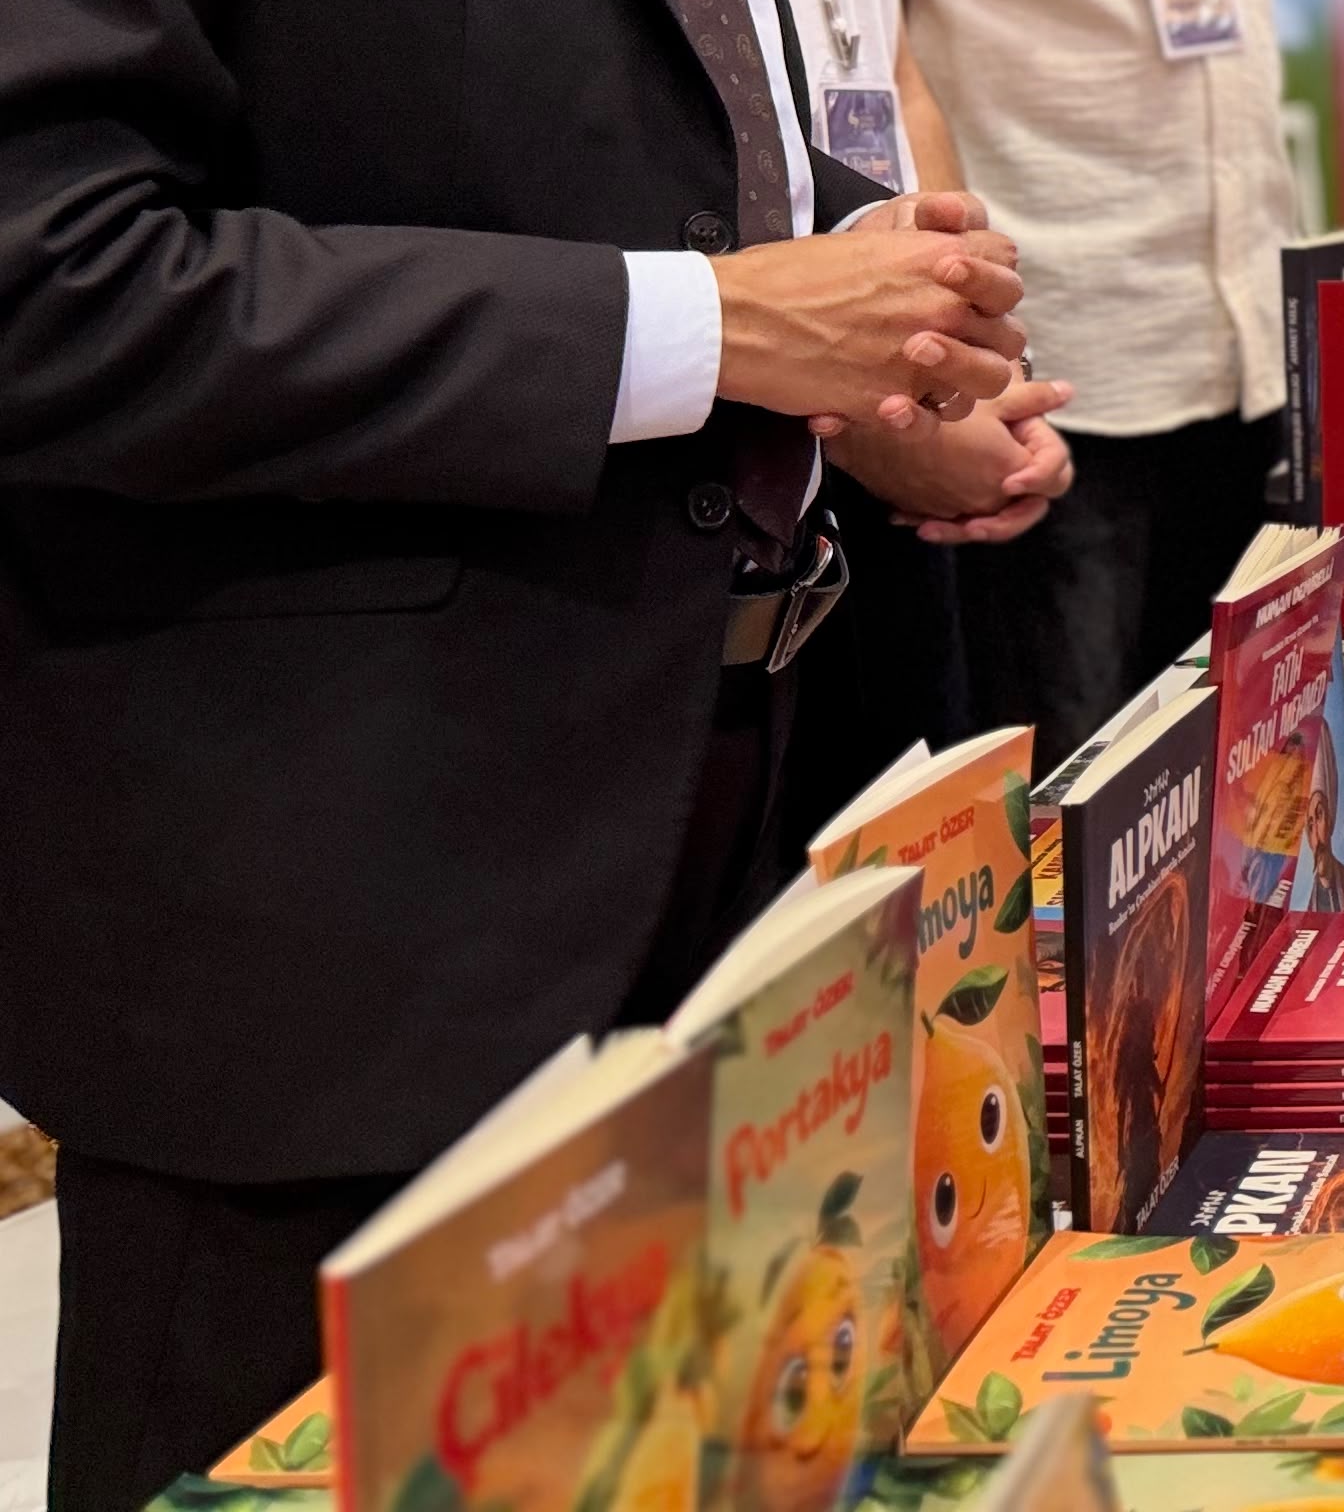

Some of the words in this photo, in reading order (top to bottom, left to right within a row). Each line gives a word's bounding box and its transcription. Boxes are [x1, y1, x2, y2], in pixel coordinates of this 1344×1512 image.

[1255, 590, 1291, 628] NUMAN
[1291, 556, 1335, 607] DEMİRELLİ
[1270, 644, 1304, 706] FATİH
[1226, 709, 1278, 784] SULTAN
[1278, 670, 1328, 740] MEHMED
[898, 833, 936, 866] TALAT
[939, 806, 975, 846] ÖZER
[1108, 765, 1201, 909] ALPKAN
[1250, 976, 1290, 1013] NUMAN
[1274, 930, 1319, 978] DEMİRELLİ
[1074, 1040, 1083, 1068] ÖZER
[1074, 1069, 1083, 1099] TALAT
[725, 1030, 892, 1222] Portakya
[1075, 1119, 1085, 1158] ALPKAN
[1213, 1150, 1318, 1234] PKAN
[1010, 1322, 1056, 1362] TALAT
[1035, 1287, 1082, 1321] ÖZER
[1041, 1273, 1197, 1382] Limoya
